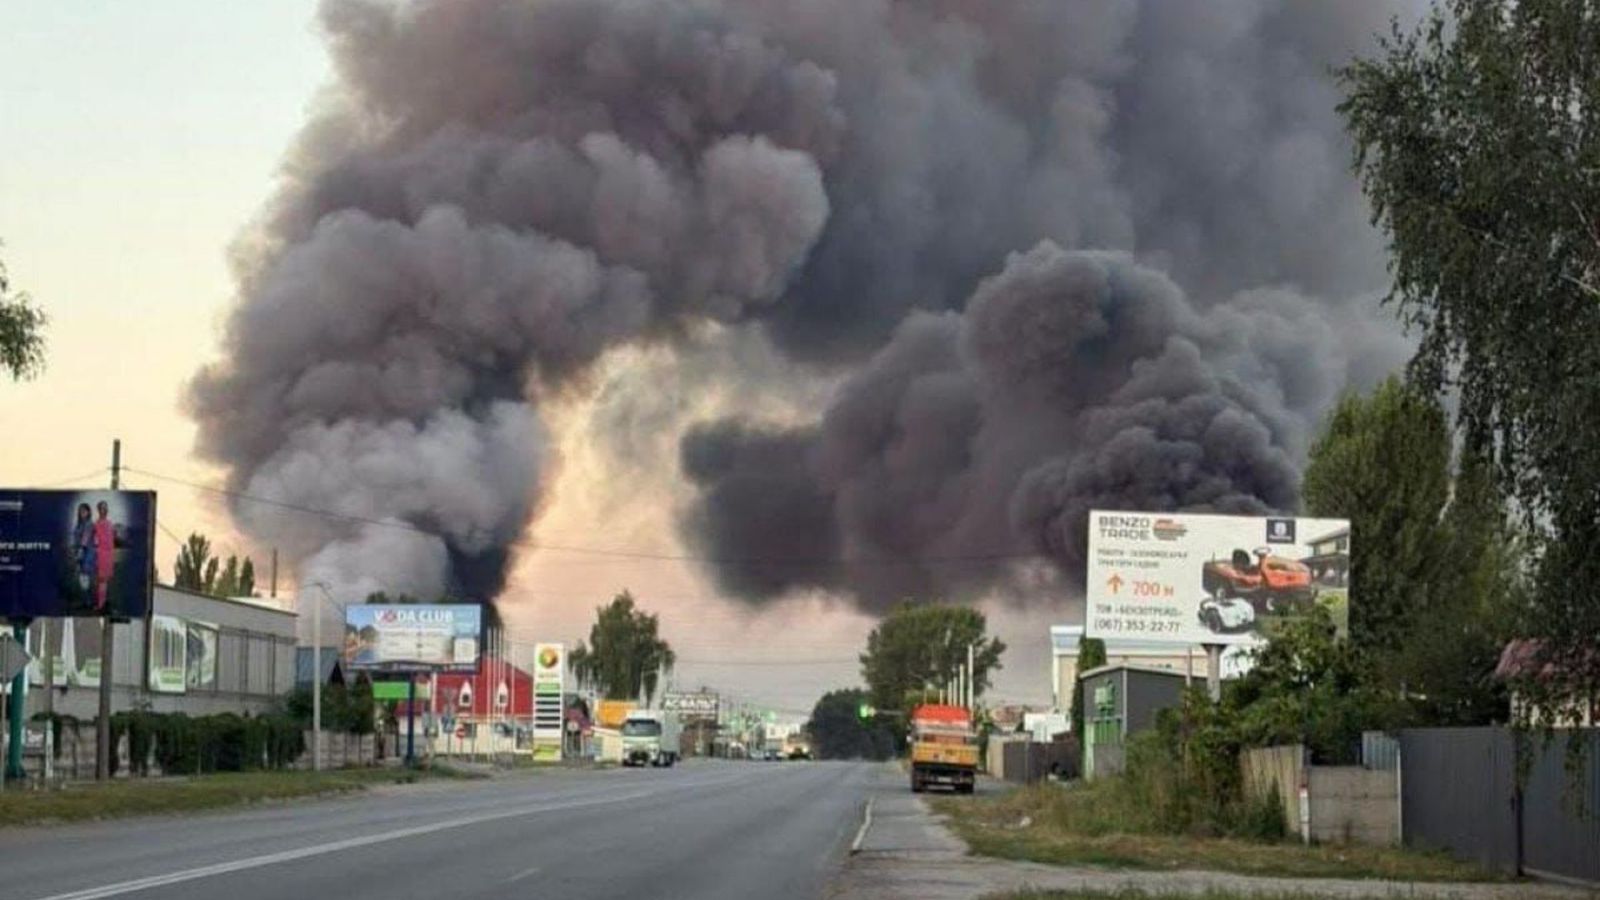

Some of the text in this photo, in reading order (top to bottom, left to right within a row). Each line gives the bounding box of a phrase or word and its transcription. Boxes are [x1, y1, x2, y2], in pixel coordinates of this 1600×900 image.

[1098, 516, 1150, 528] BENZO
[1099, 528, 1150, 540] TRADE
[1132, 581, 1160, 596] 700
[418, 610, 454, 622] CLUB
[1094, 619, 1181, 632] (067) 353-22-77
